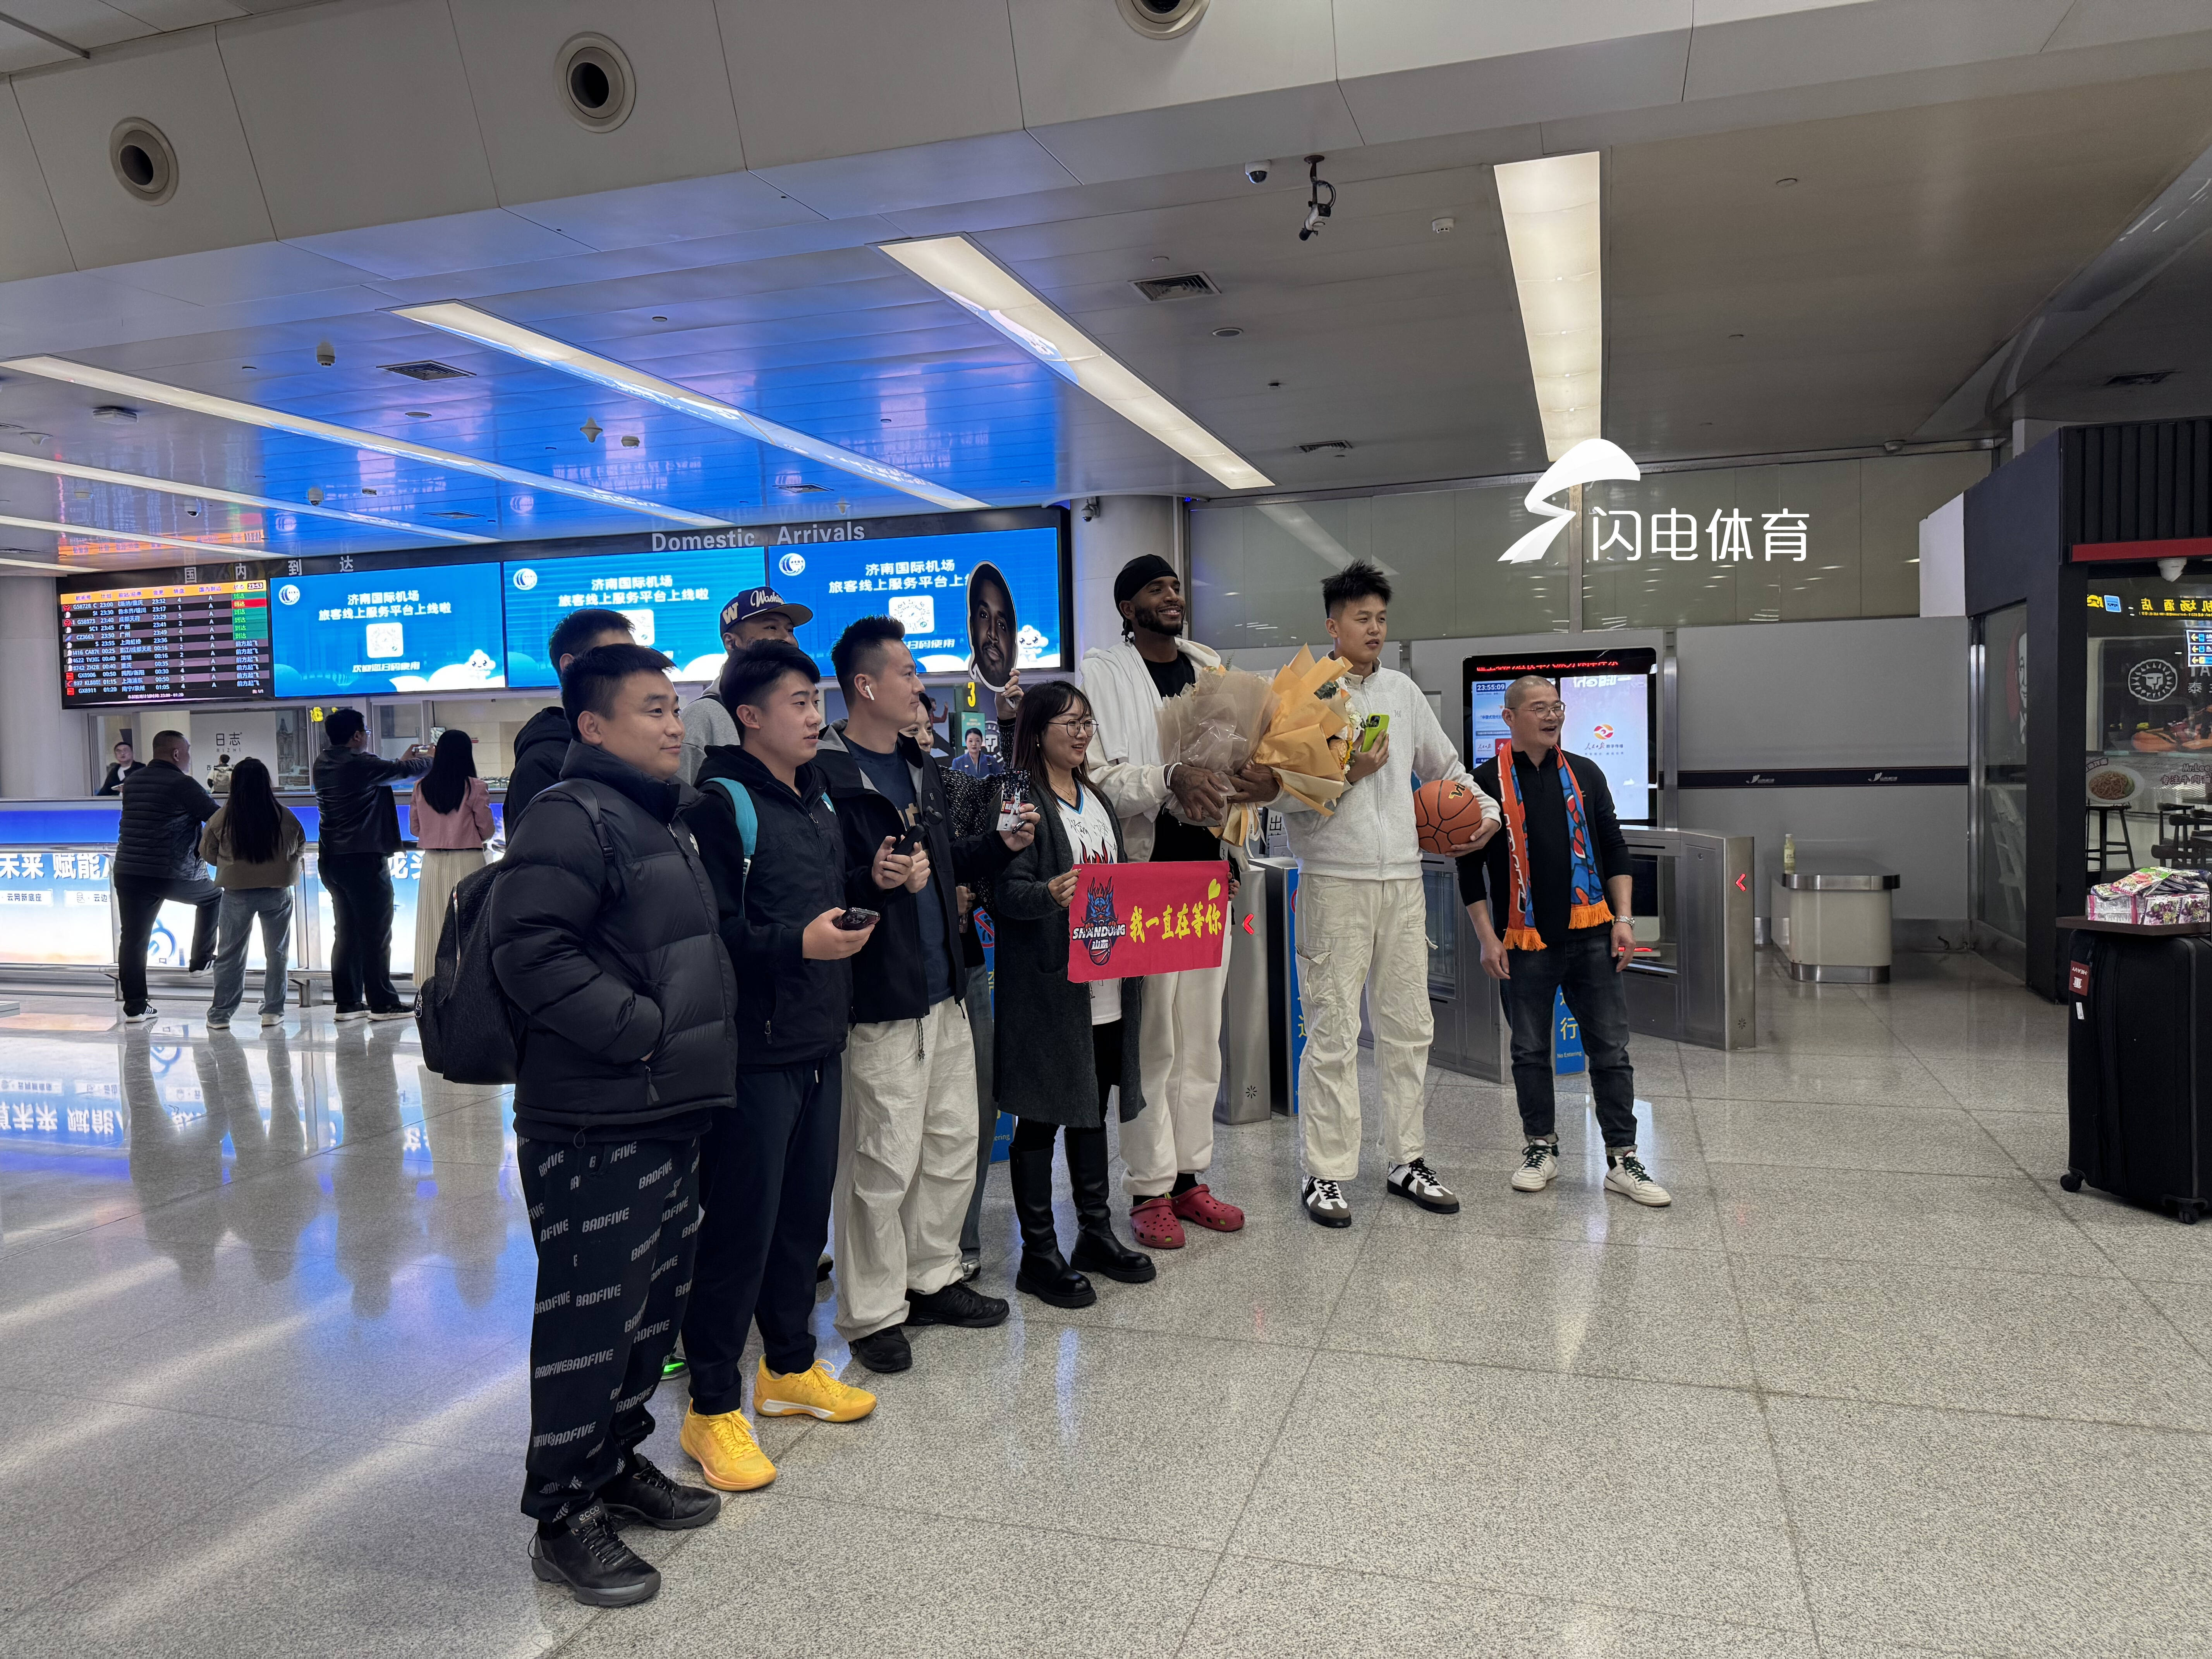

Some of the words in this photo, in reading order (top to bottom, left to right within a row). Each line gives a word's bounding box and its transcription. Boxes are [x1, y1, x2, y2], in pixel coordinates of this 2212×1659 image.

[652, 528, 756, 551] Domestic
[777, 522, 865, 545] Arrivals
[865, 559, 955, 576] 济南国际机场
[591, 575, 673, 591] 济南国际机场
[347, 590, 419, 605] 济南国际机场
[558, 588, 709, 607] 旅客线上服务平台上线啦
[318, 602, 452, 621] 旅客线上服务平台上线啦
[722, 602, 739, 625] W
[967, 682, 976, 707] 3
[216, 732, 240, 745] 日志
[1072, 924, 1126, 939] SHANDONG
[1130, 901, 1222, 944] 我一直在等你
[2072, 966, 2087, 975] HEAVY
[639, 1158, 672, 1190] BADFIVE
[582, 1207, 630, 1233] BADFIVE
[534, 1290, 570, 1314] BADFIVE
[576, 1284, 622, 1307] BADFIVE
[579, 1505, 600, 1521] ecco
